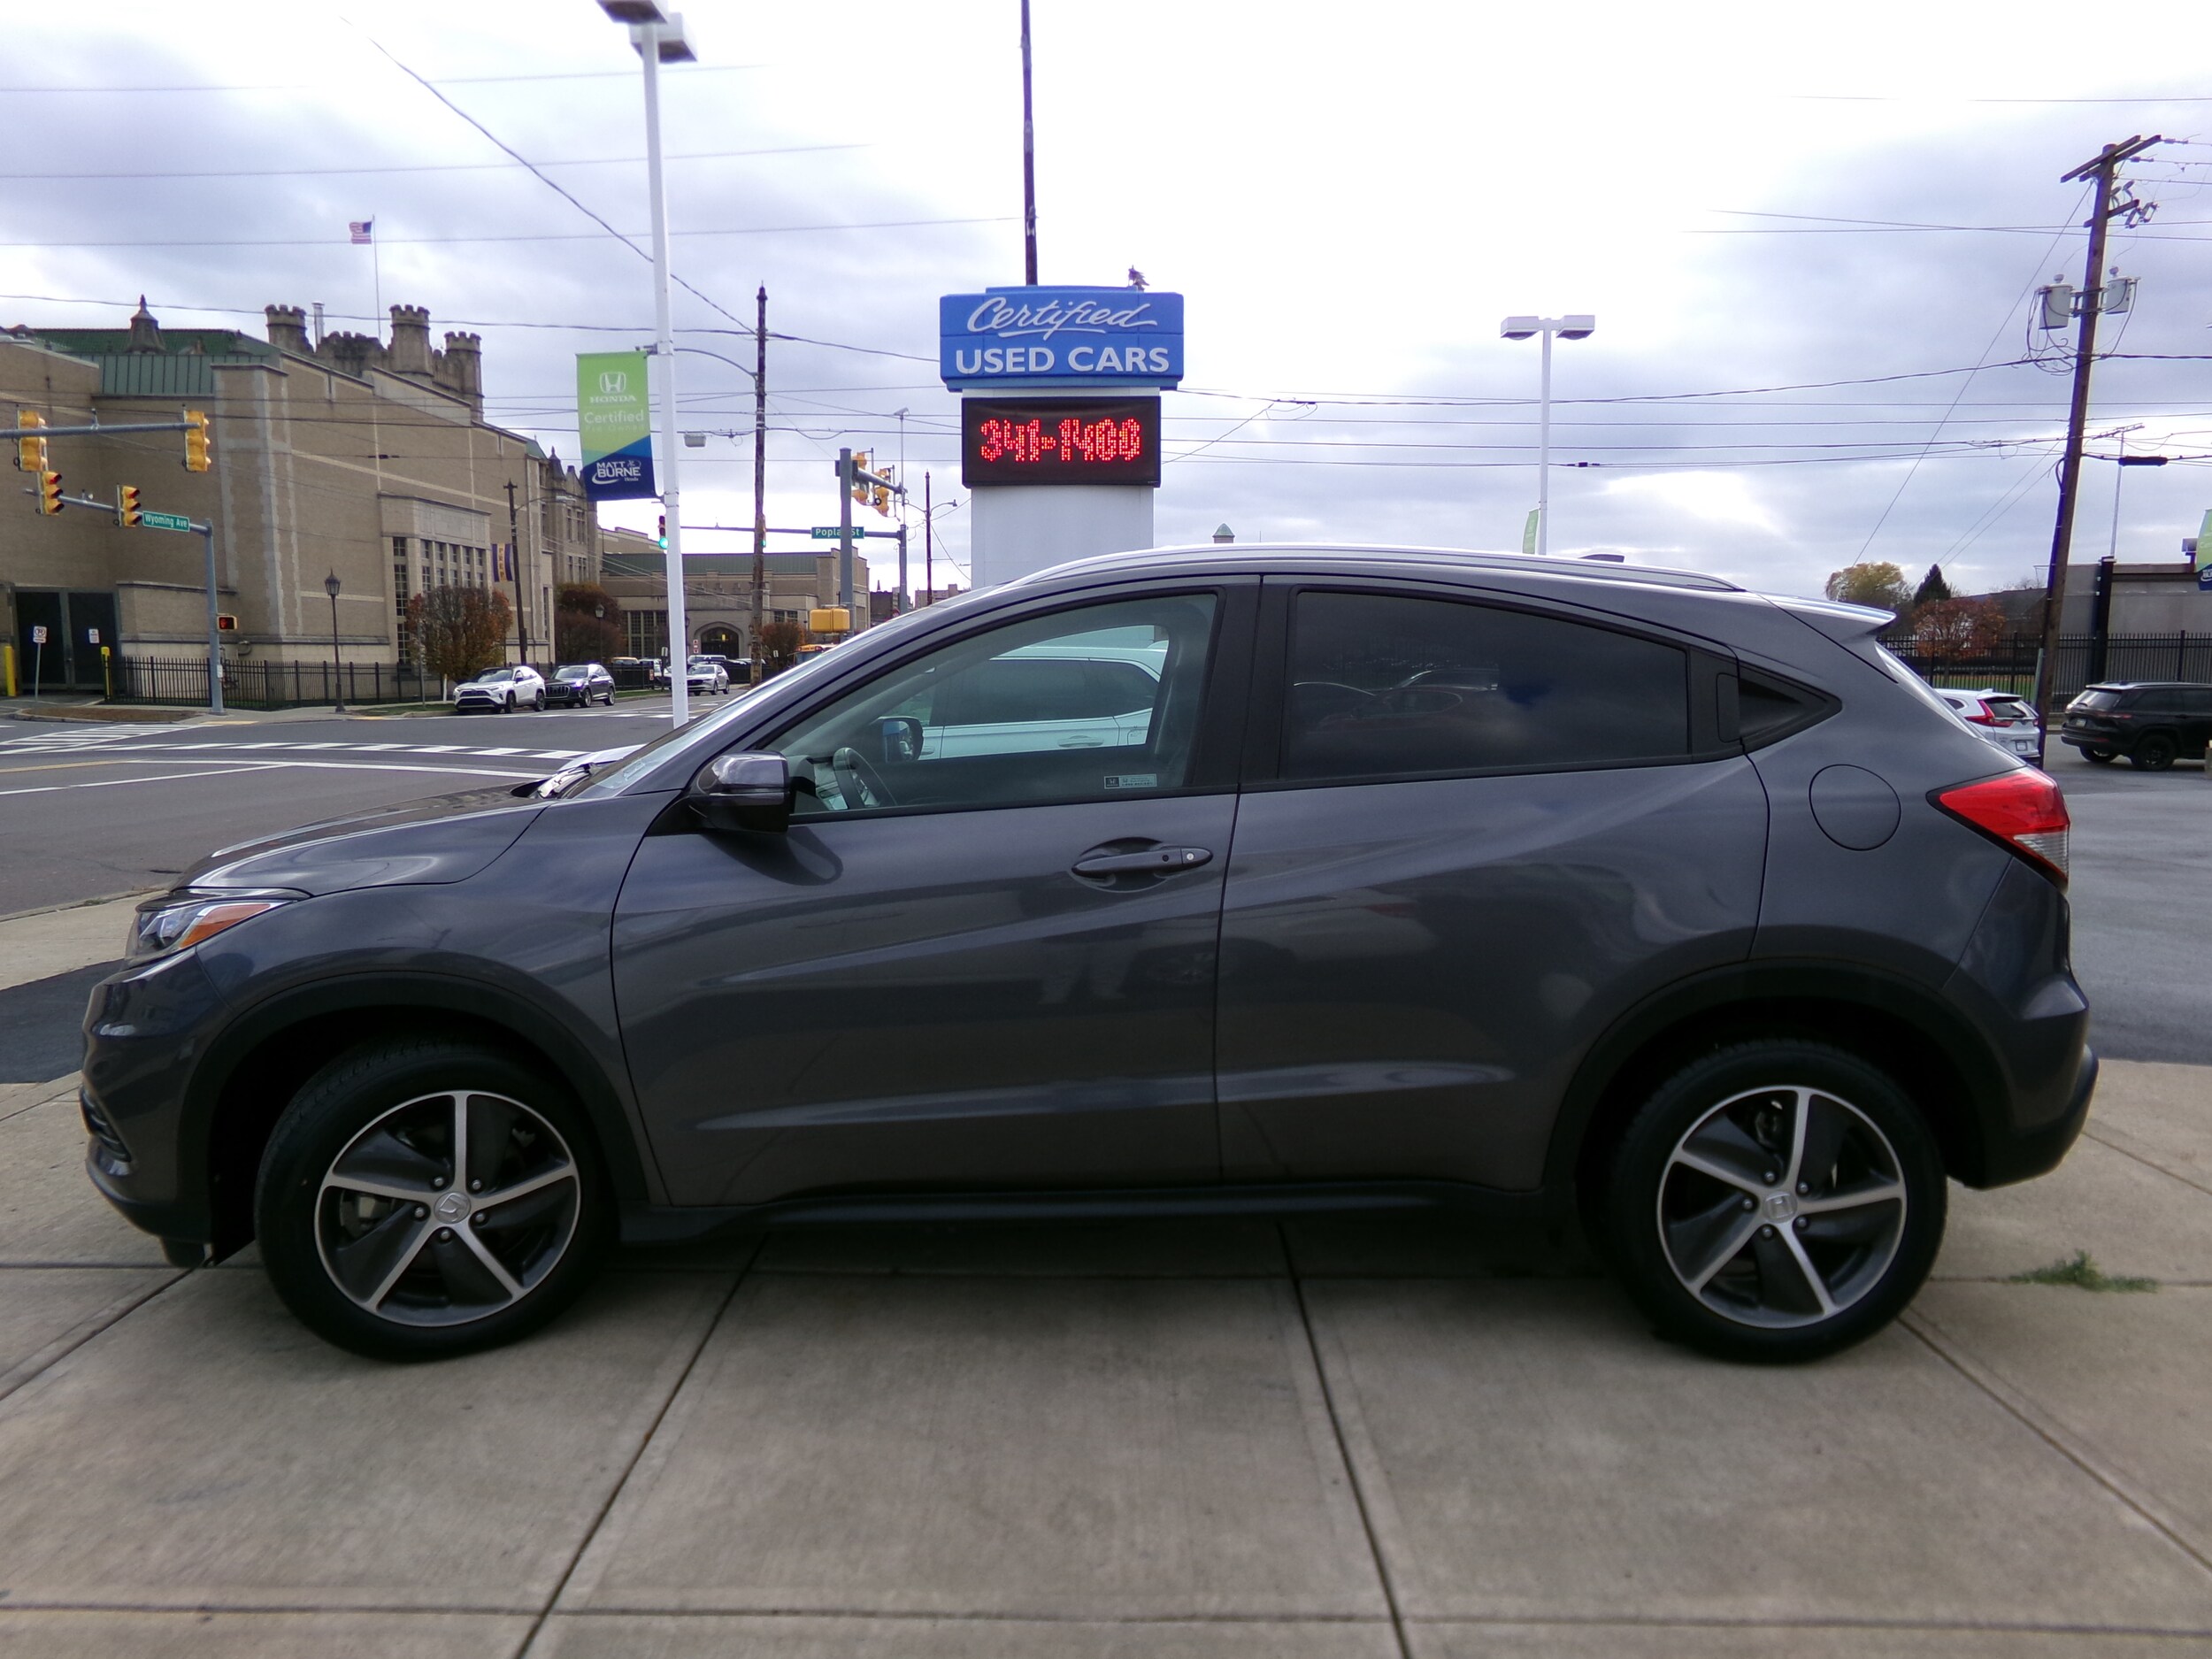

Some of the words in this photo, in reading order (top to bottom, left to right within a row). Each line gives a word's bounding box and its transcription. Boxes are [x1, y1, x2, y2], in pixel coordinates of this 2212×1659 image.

[966, 296, 1158, 341] Certified
[955, 348, 1056, 374] USED
[1067, 347, 1170, 373] CARS
[588, 395, 638, 404] HONDA
[584, 408, 645, 425] Certified
[980, 419, 1141, 462] 341-1400
[597, 466, 641, 479] BURNE
[144, 513, 174, 528] Wyoming
[175, 518, 188, 528] Ave
[815, 527, 841, 538] Popla
[851, 527, 860, 536] St
